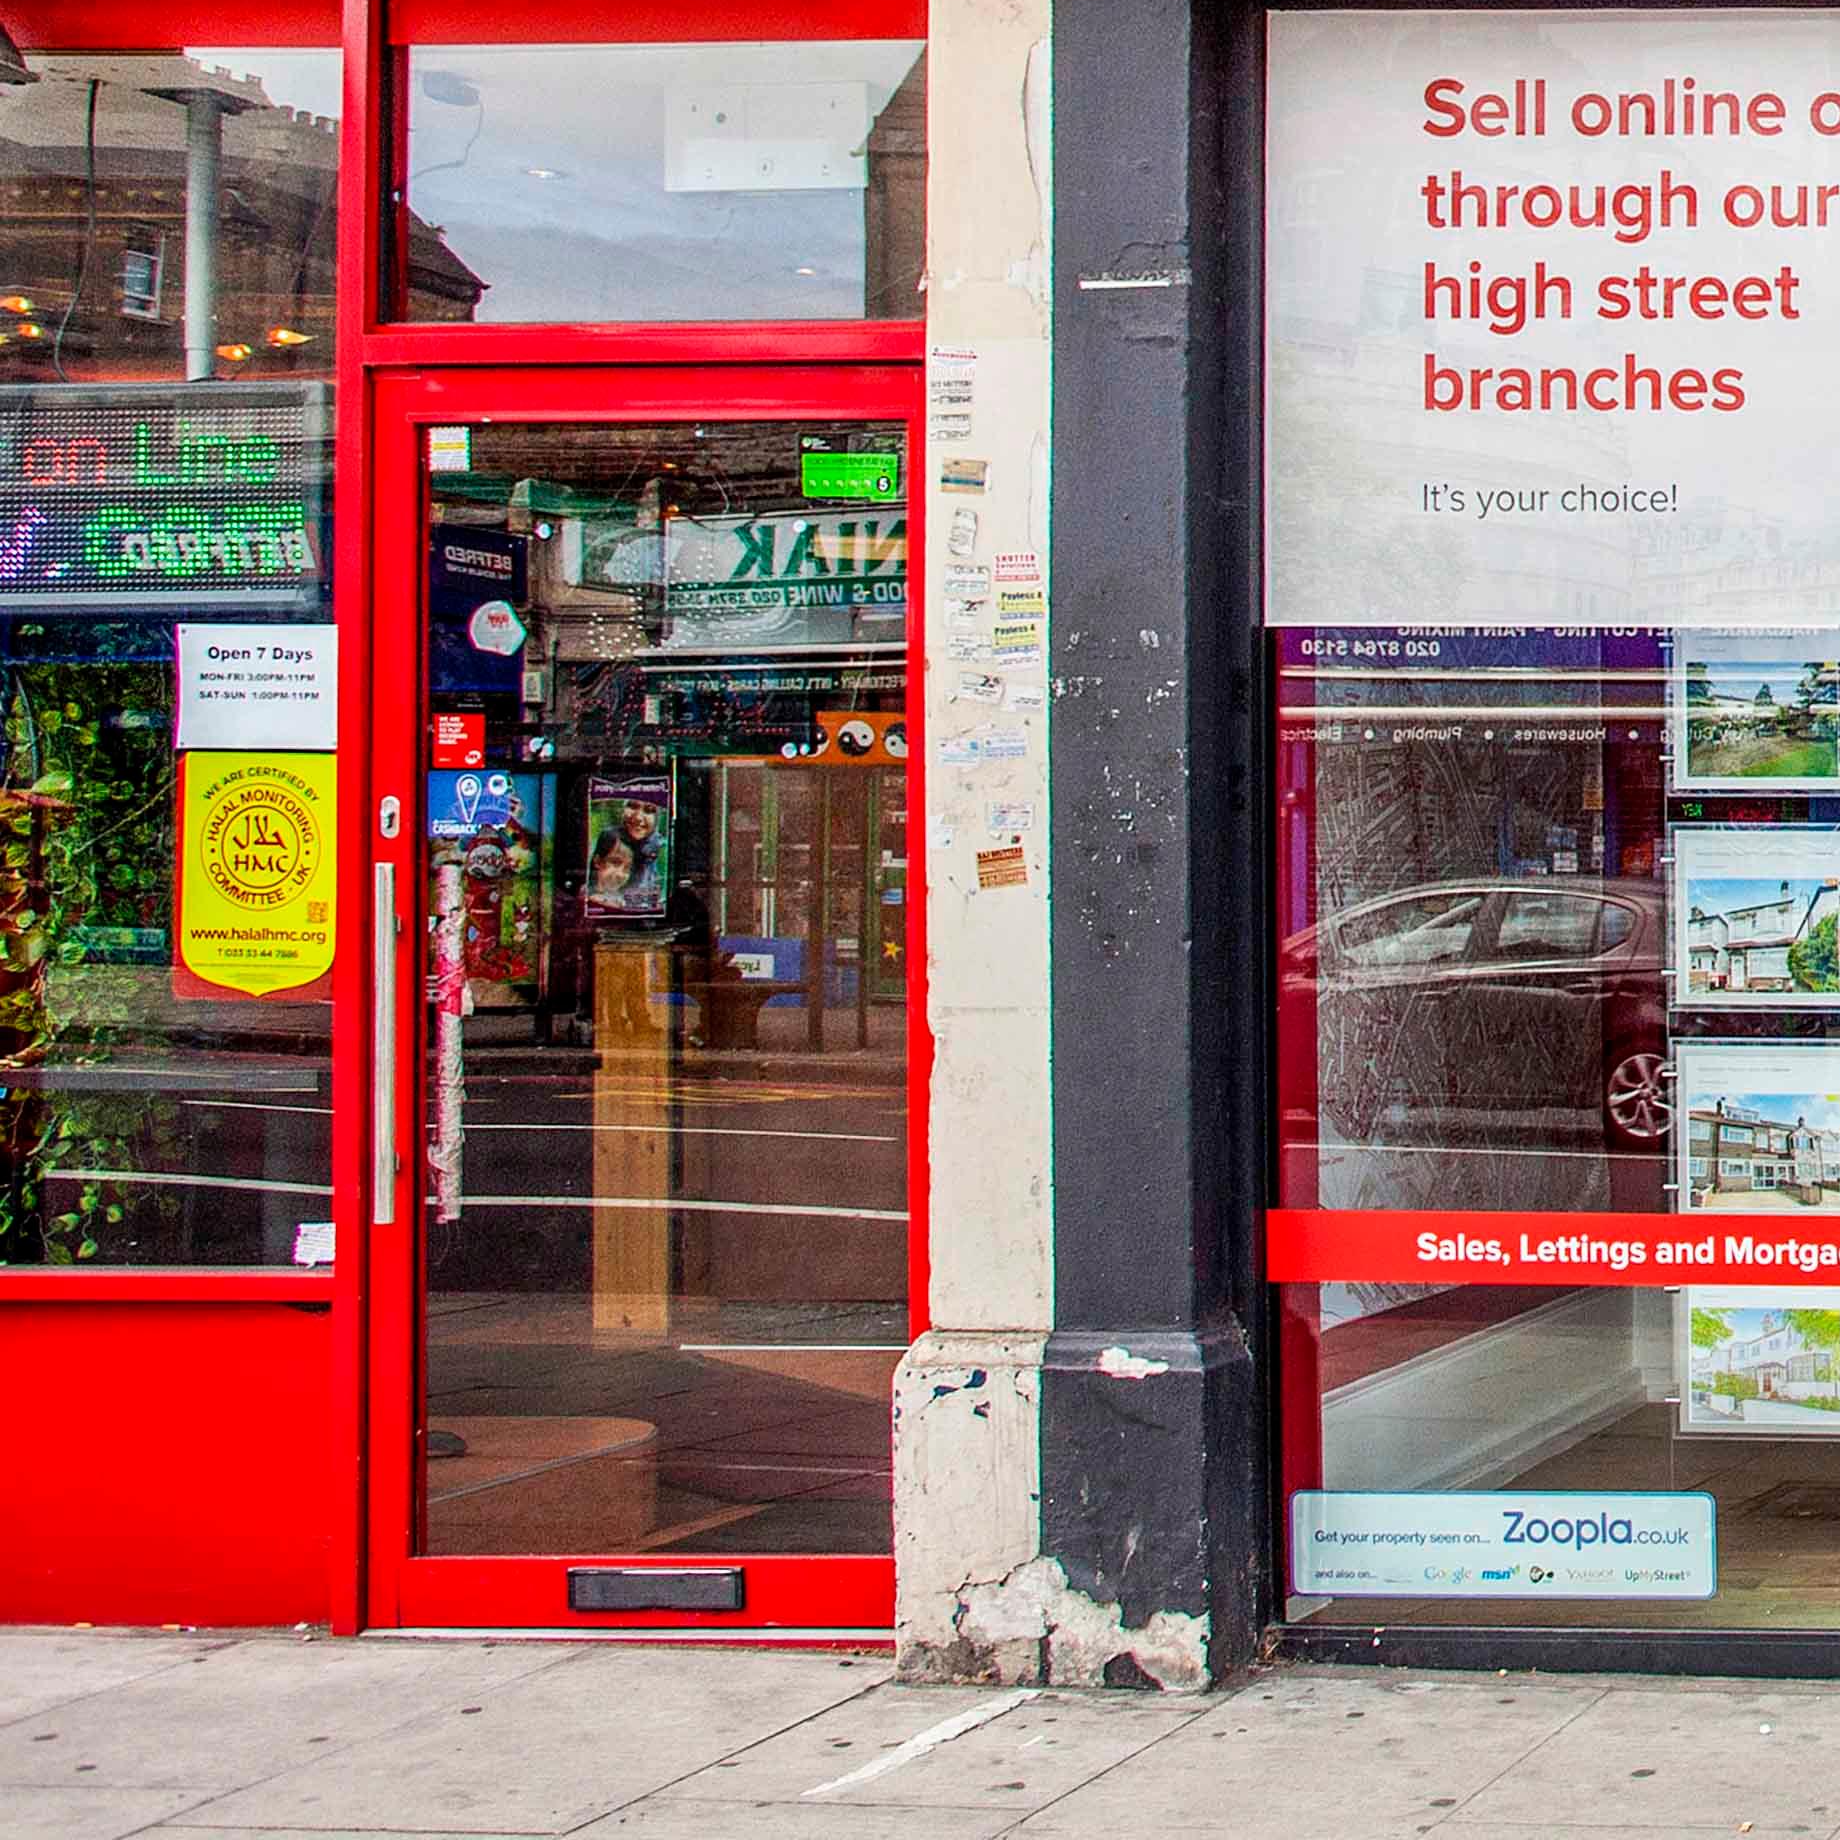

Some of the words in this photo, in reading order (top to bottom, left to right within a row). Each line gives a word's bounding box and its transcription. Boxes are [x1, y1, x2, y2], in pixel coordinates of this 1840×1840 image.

[1421, 76, 1547, 137] Sell
[1570, 76, 1787, 137] online
[1421, 170, 1697, 244] through
[1723, 184, 1840, 229] our
[1423, 261, 1571, 335] high
[1597, 266, 1801, 320] street
[1423, 353, 1746, 412] branches
[134, 421, 279, 485] Line
[1421, 483, 1468, 513] It's
[1476, 491, 1551, 521] your
[1560, 483, 1679, 513] choice!
[207, 646, 251, 663] Open
[257, 646, 267, 661] 7
[272, 646, 314, 663] Days
[199, 690, 246, 700] SAT-SUN
[203, 782, 219, 801] WE
[218, 769, 245, 791] ARE
[248, 767, 306, 792] CERTIFIED
[305, 783, 321, 802] BY
[208, 799, 240, 843] HALAL
[240, 791, 315, 844] MONITORING
[233, 855, 289, 874] HMC
[209, 862, 286, 906] COMMITTEE
[293, 864, 312, 888] UK
[190, 927, 326, 946] www.halalhmc.org
[1416, 1232, 1510, 1268] Sales,
[1519, 1233, 1647, 1270] Lettings
[1655, 1235, 1715, 1265] and
[1314, 1529, 1338, 1543] Get
[1341, 1533, 1370, 1545] your
[1372, 1531, 1426, 1546] property
[1429, 1533, 1460, 1544] seen
[1314, 1569, 1333, 1579] and
[1334, 1569, 1353, 1579] also
[1424, 1565, 1473, 1583] Google
[1481, 1568, 1511, 1580] msn
